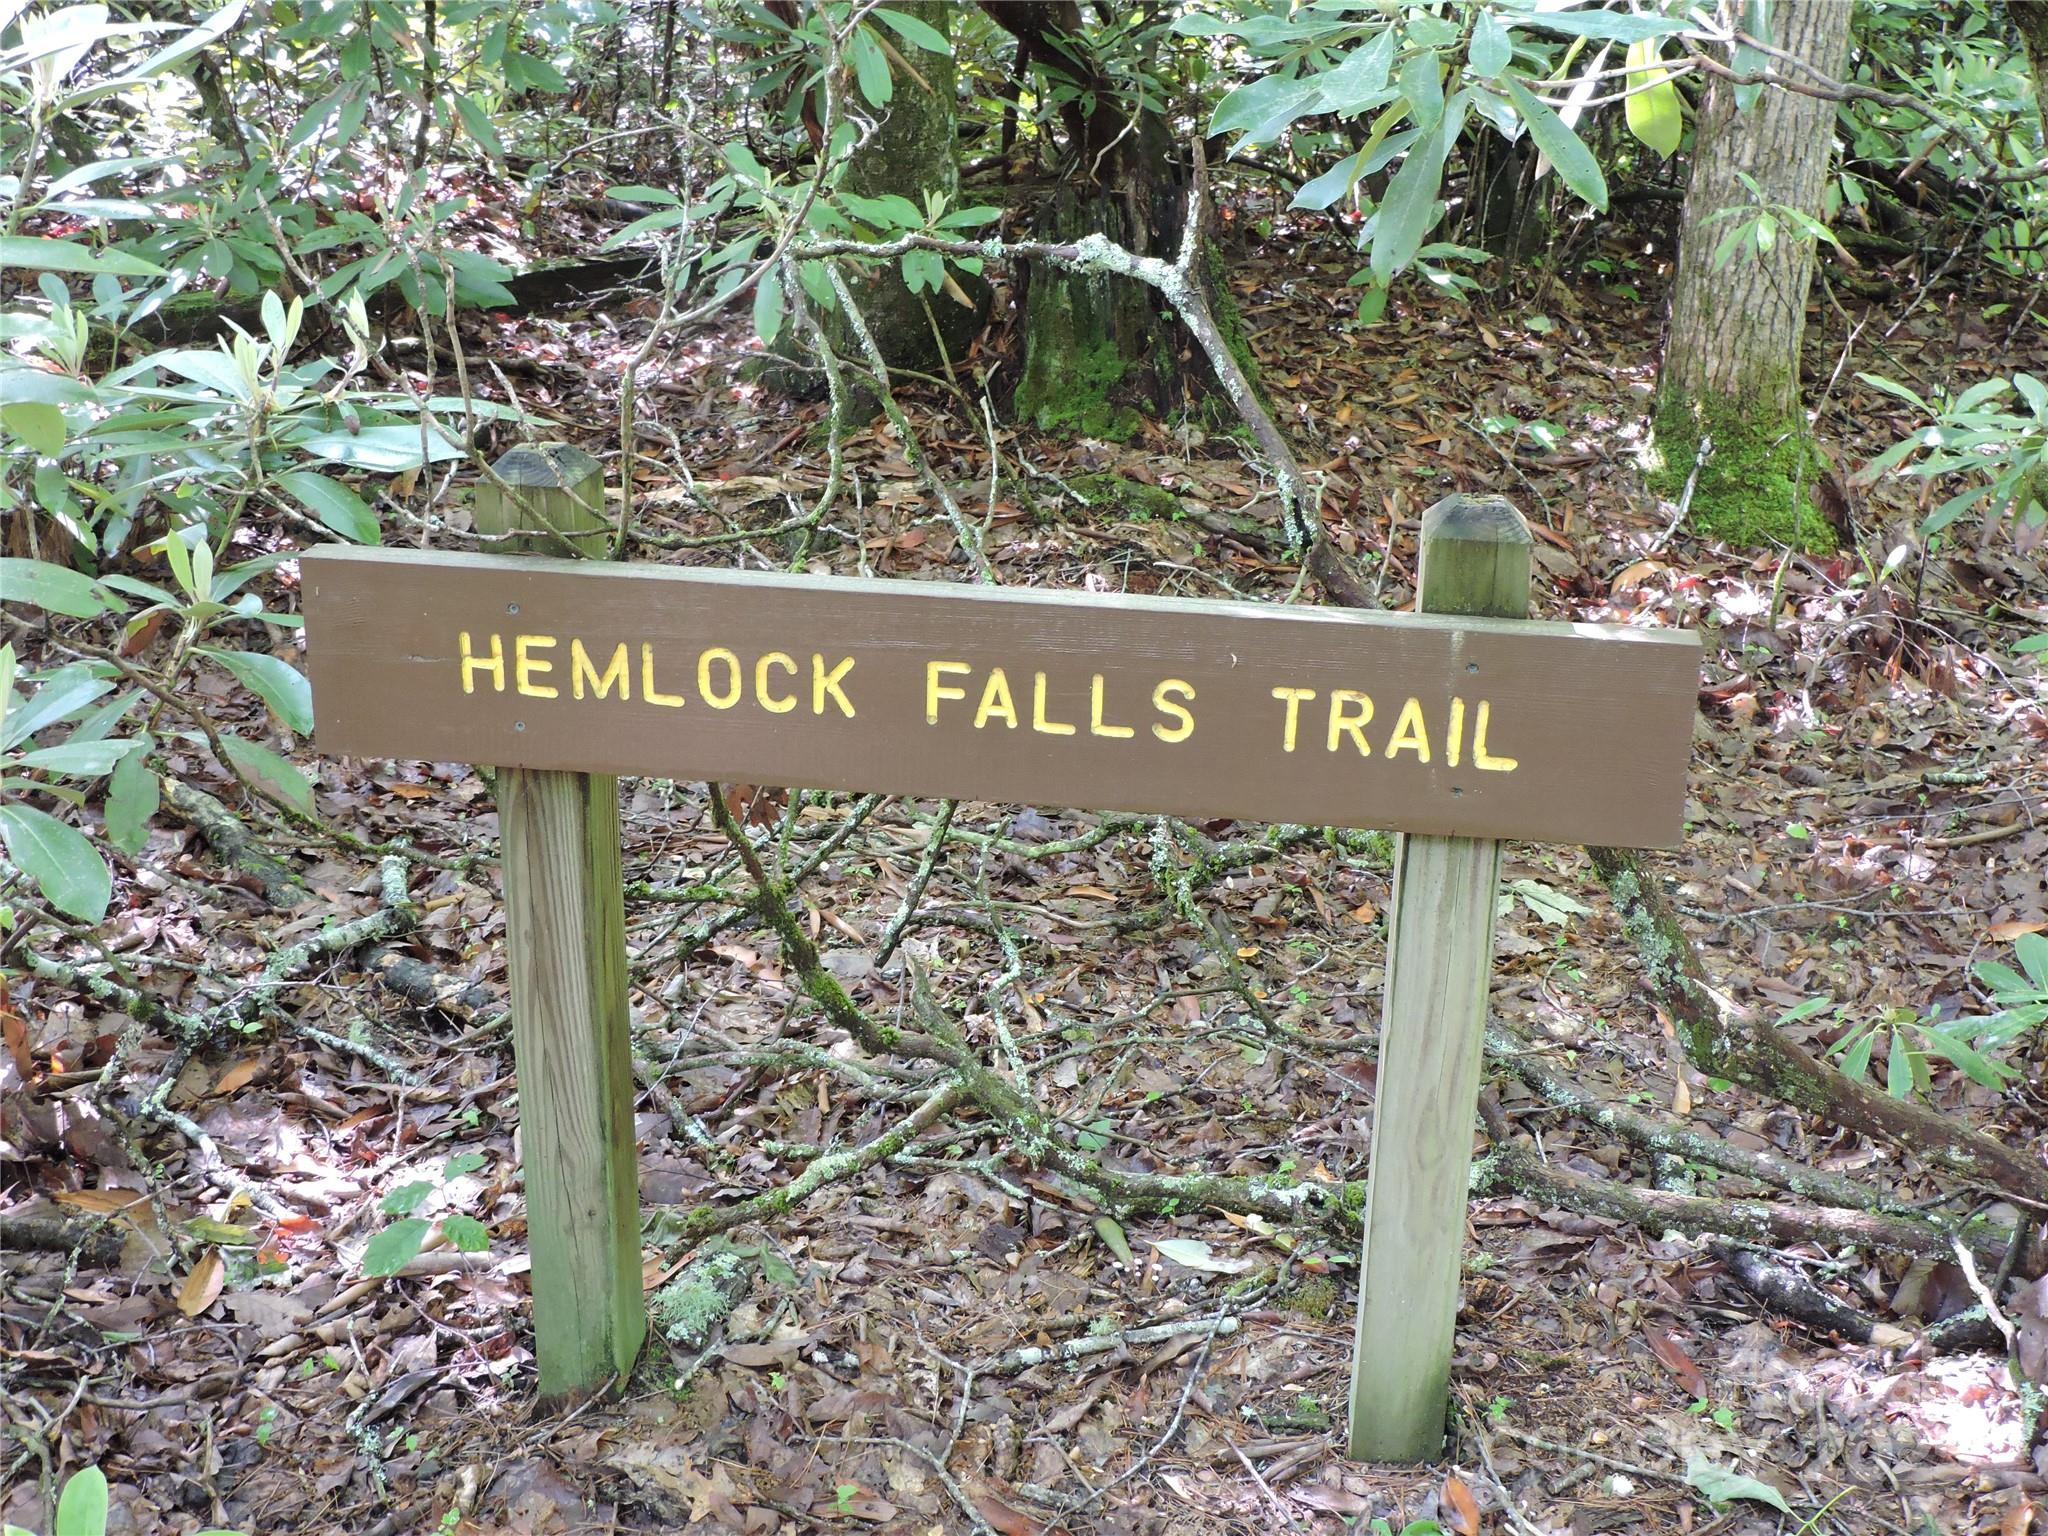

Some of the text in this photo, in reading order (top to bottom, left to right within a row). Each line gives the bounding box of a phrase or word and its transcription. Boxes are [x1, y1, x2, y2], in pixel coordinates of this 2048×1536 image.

[457, 630, 1520, 773] HEMLOCK FALLS TRAIL
